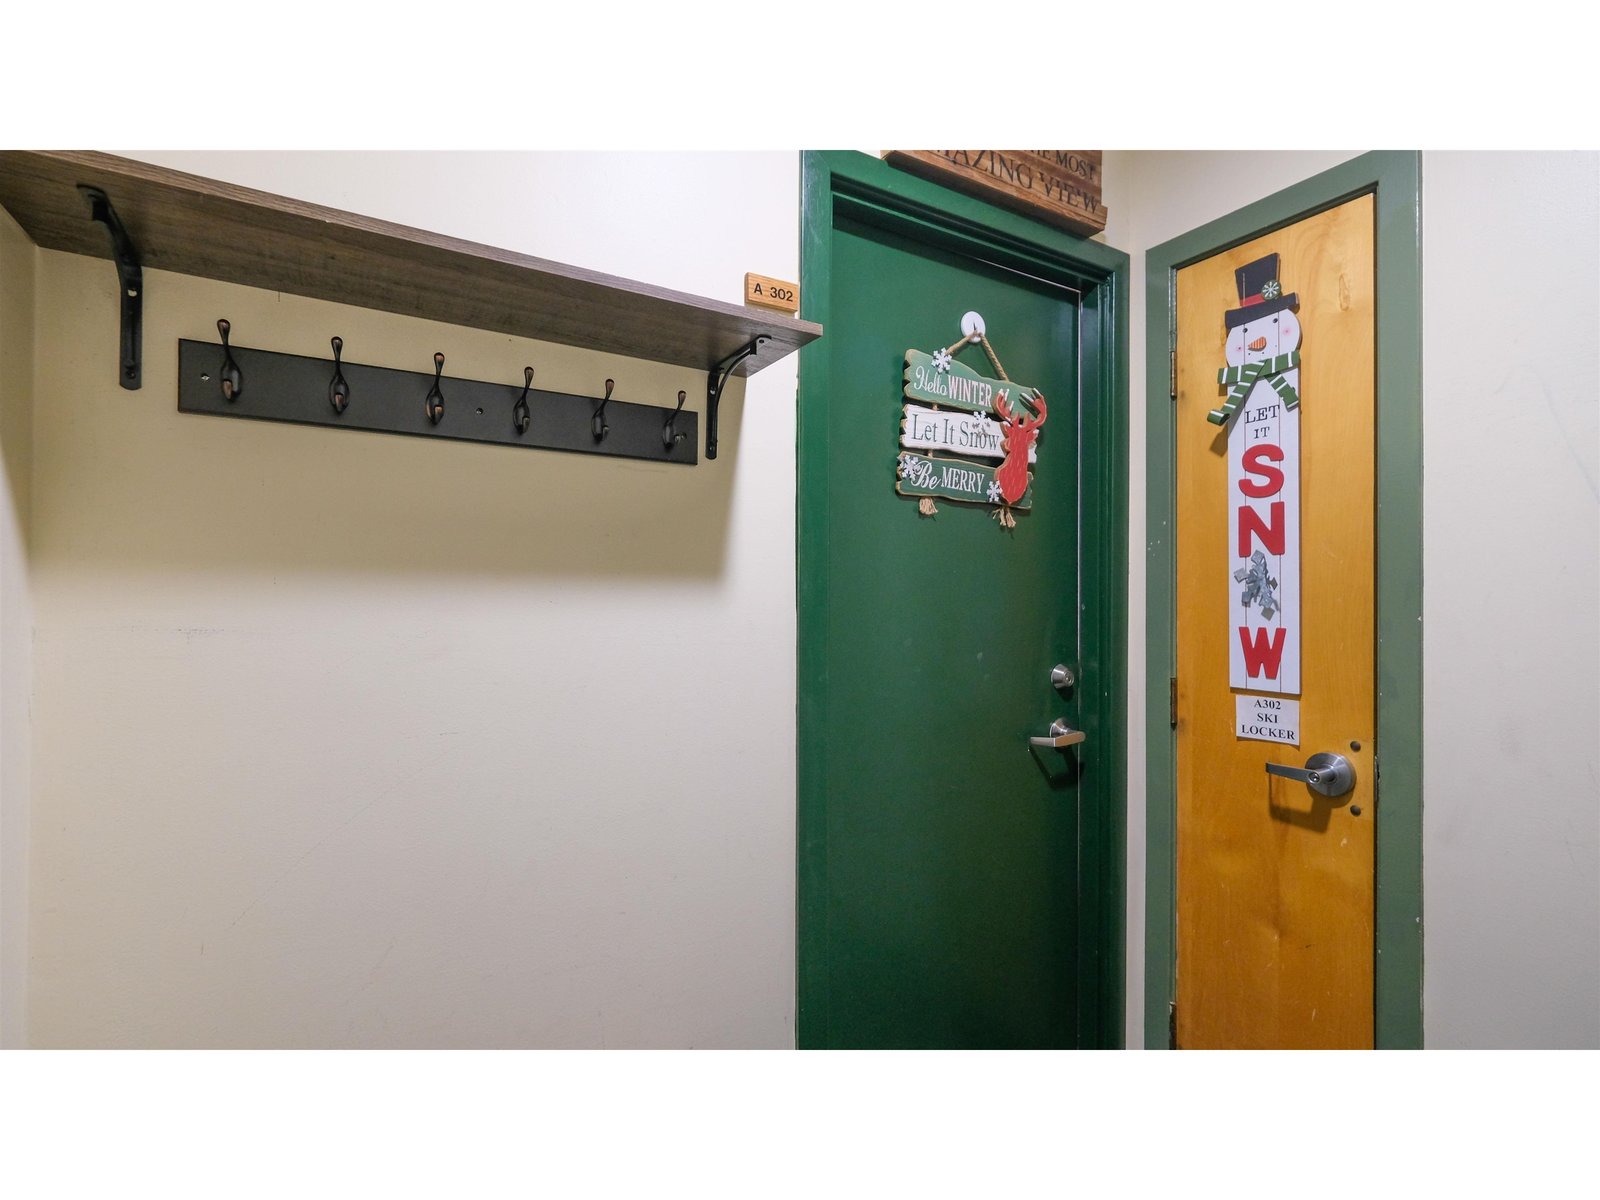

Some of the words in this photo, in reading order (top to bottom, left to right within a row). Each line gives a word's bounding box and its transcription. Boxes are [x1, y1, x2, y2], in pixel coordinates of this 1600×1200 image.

[1056, 150, 1096, 181] MOST
[1039, 171, 1098, 214] VIEW
[754, 282, 763, 295] A
[770, 286, 793, 302] 302
[914, 366, 948, 396] Hello
[948, 375, 992, 407] WINTER
[1245, 404, 1280, 424] LET
[912, 414, 938, 441] Let
[942, 418, 955, 446] It
[959, 420, 1000, 450] Snow
[1254, 426, 1270, 439] IT
[911, 460, 942, 490] Be
[941, 466, 985, 494] MERRY
[1254, 699, 1281, 709] A302
[1257, 712, 1278, 724] SKI
[1241, 724, 1295, 740] LOCKER
